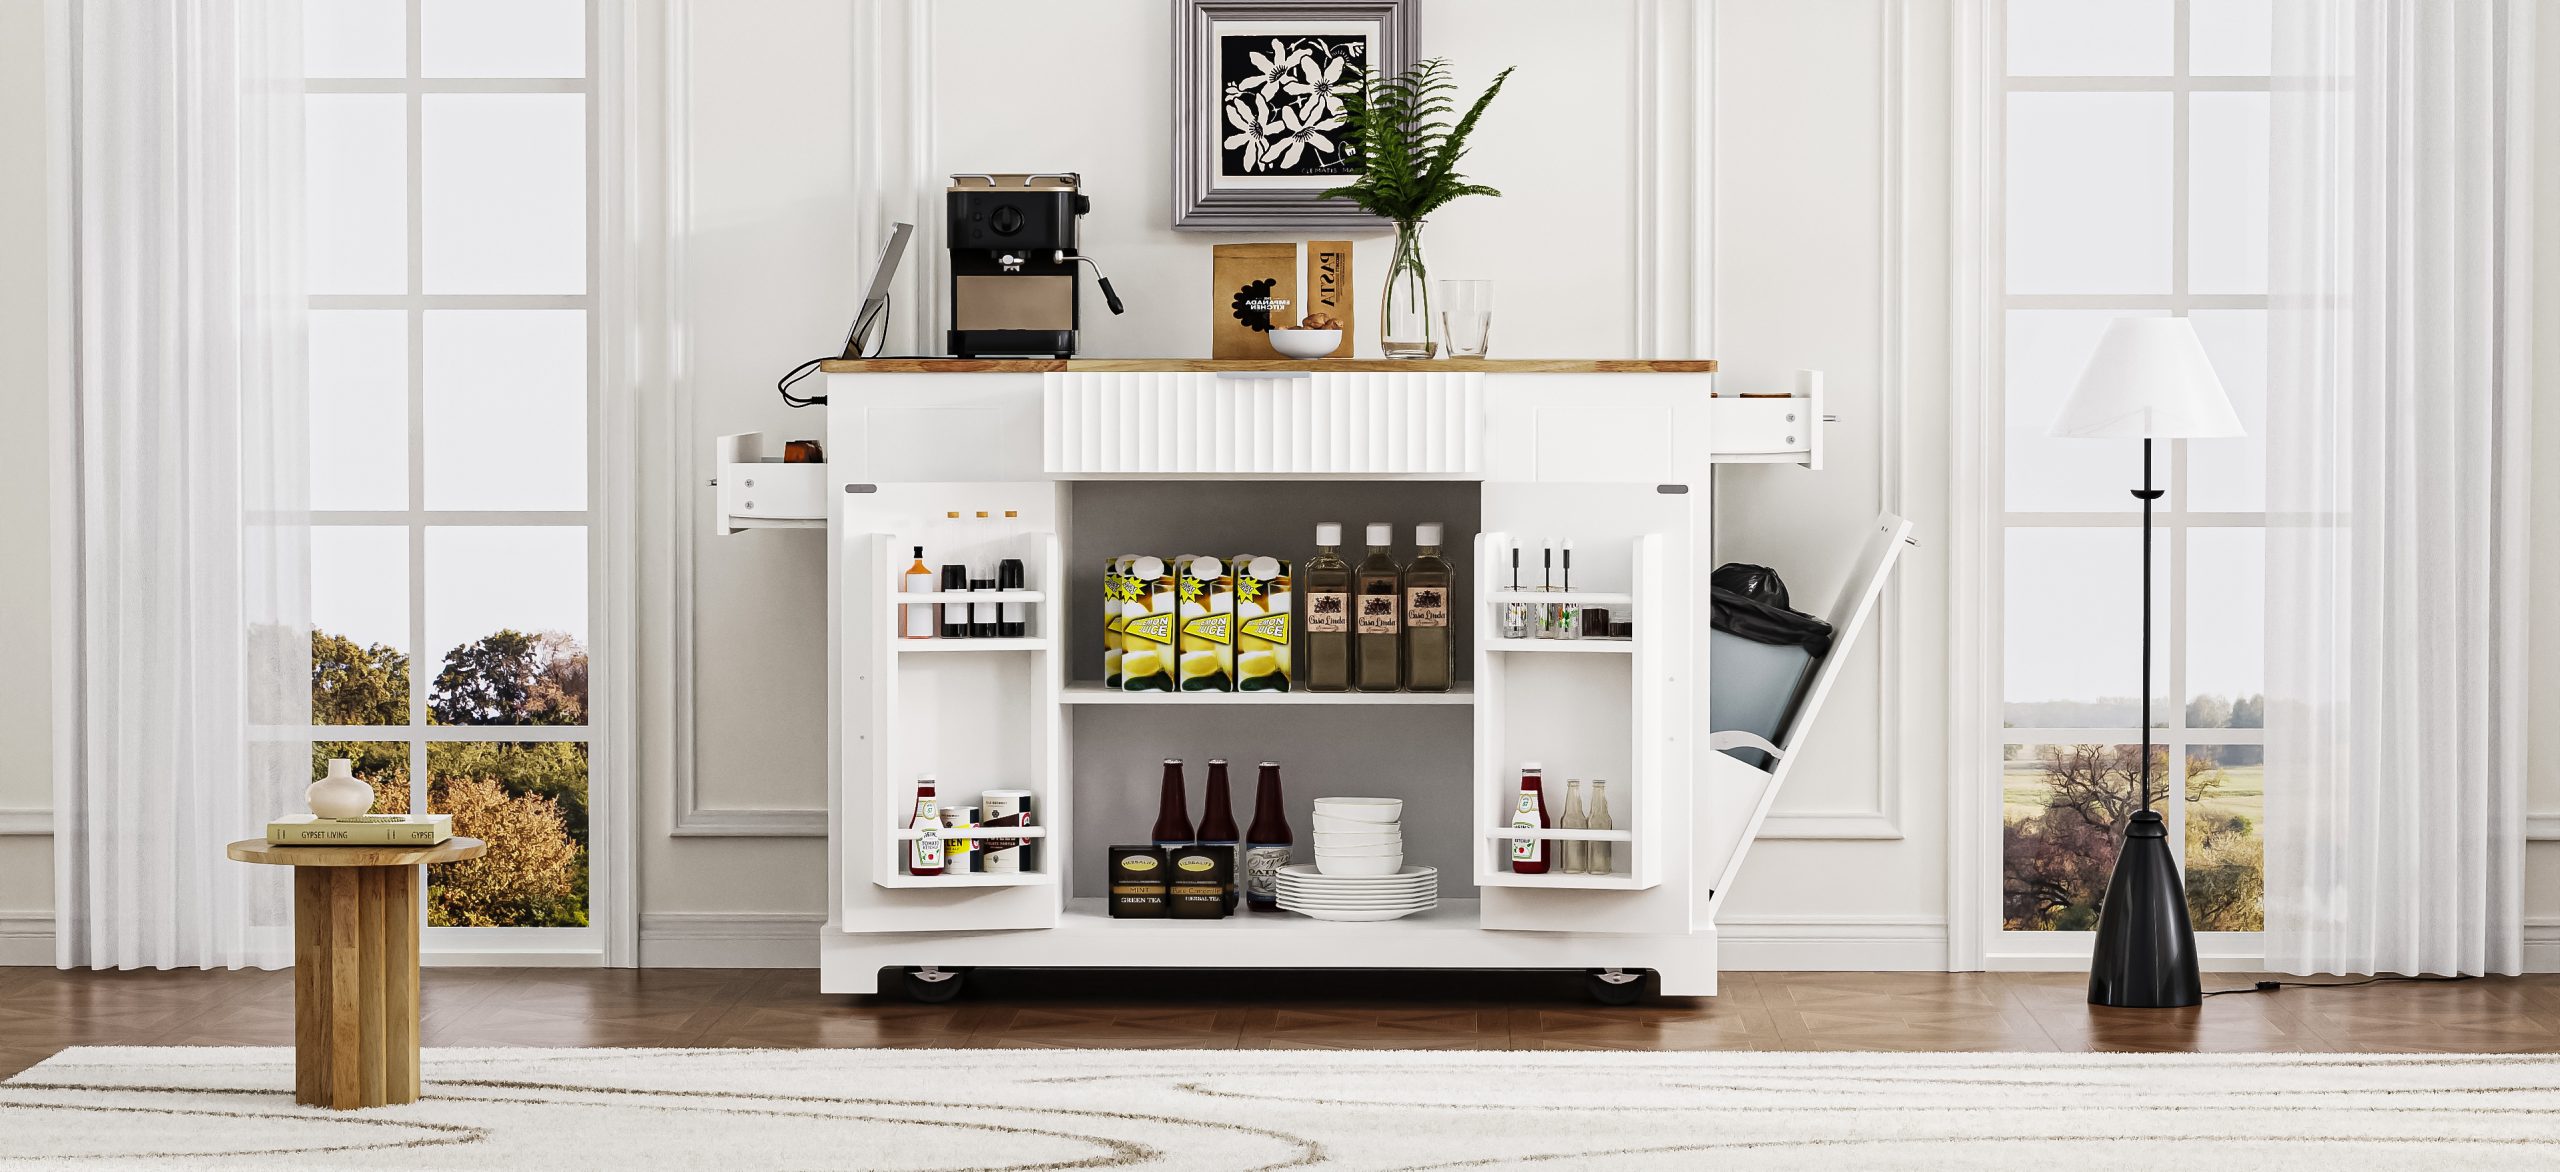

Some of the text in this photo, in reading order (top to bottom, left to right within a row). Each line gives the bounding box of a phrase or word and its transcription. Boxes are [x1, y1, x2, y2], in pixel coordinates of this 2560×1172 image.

[301, 831, 348, 839] GYPSET LIVING
[411, 831, 434, 839] GYPSET
